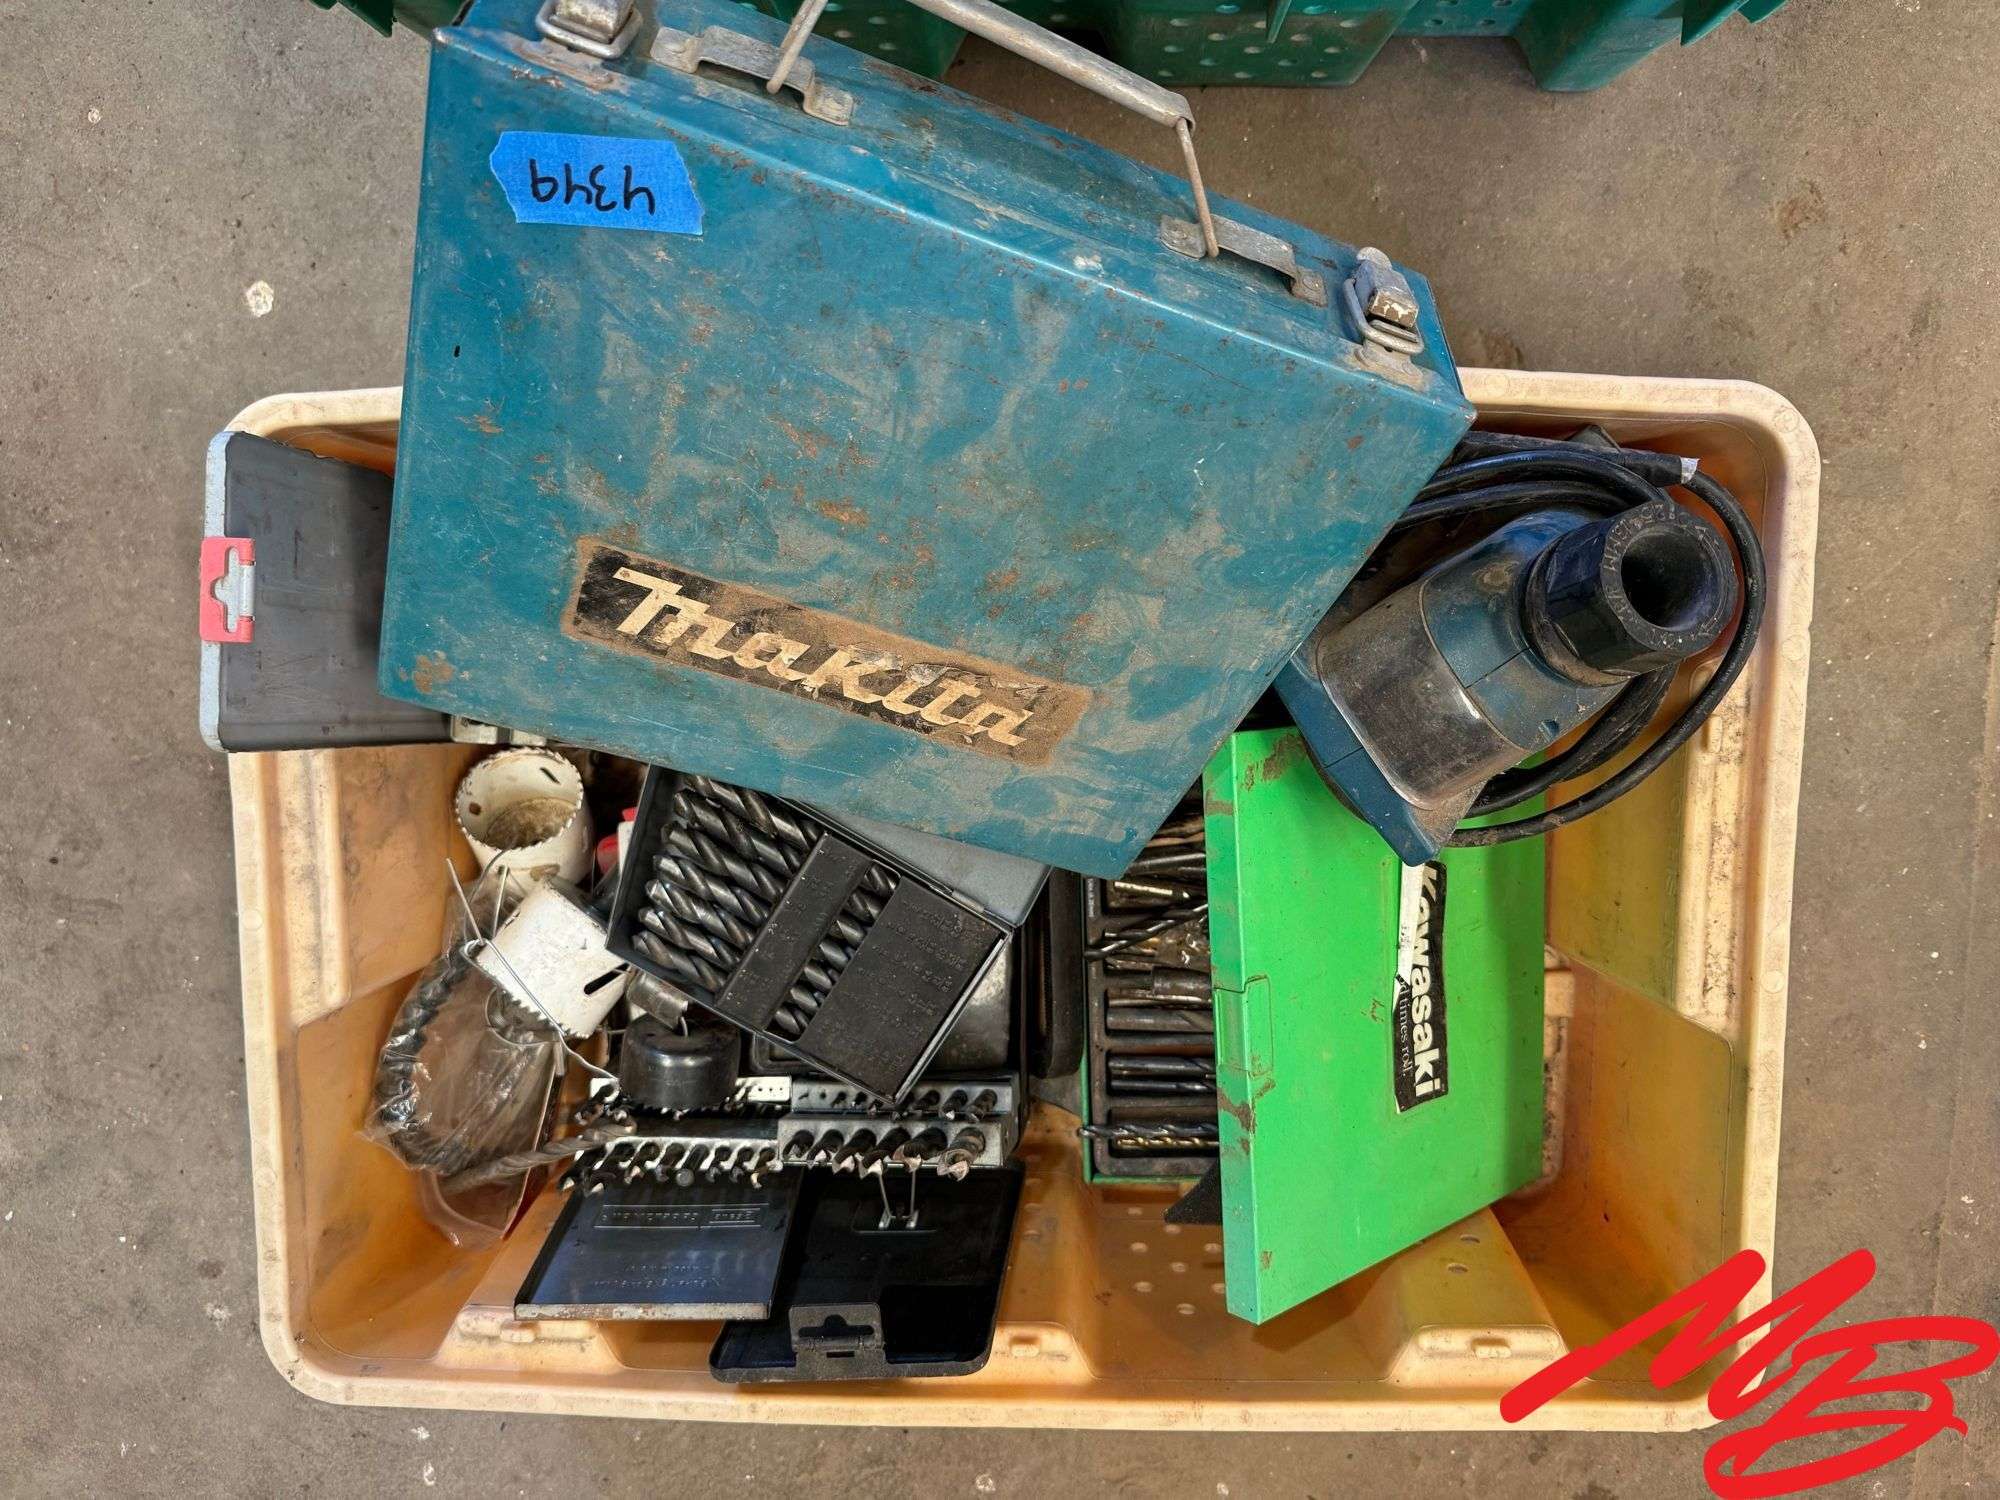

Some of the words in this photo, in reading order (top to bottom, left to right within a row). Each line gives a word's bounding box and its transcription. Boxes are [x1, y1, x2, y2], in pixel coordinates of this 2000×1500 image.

[528, 157, 656, 216] 4349
[1399, 998, 1412, 1043] times
[1401, 1047, 1413, 1078] roll.
